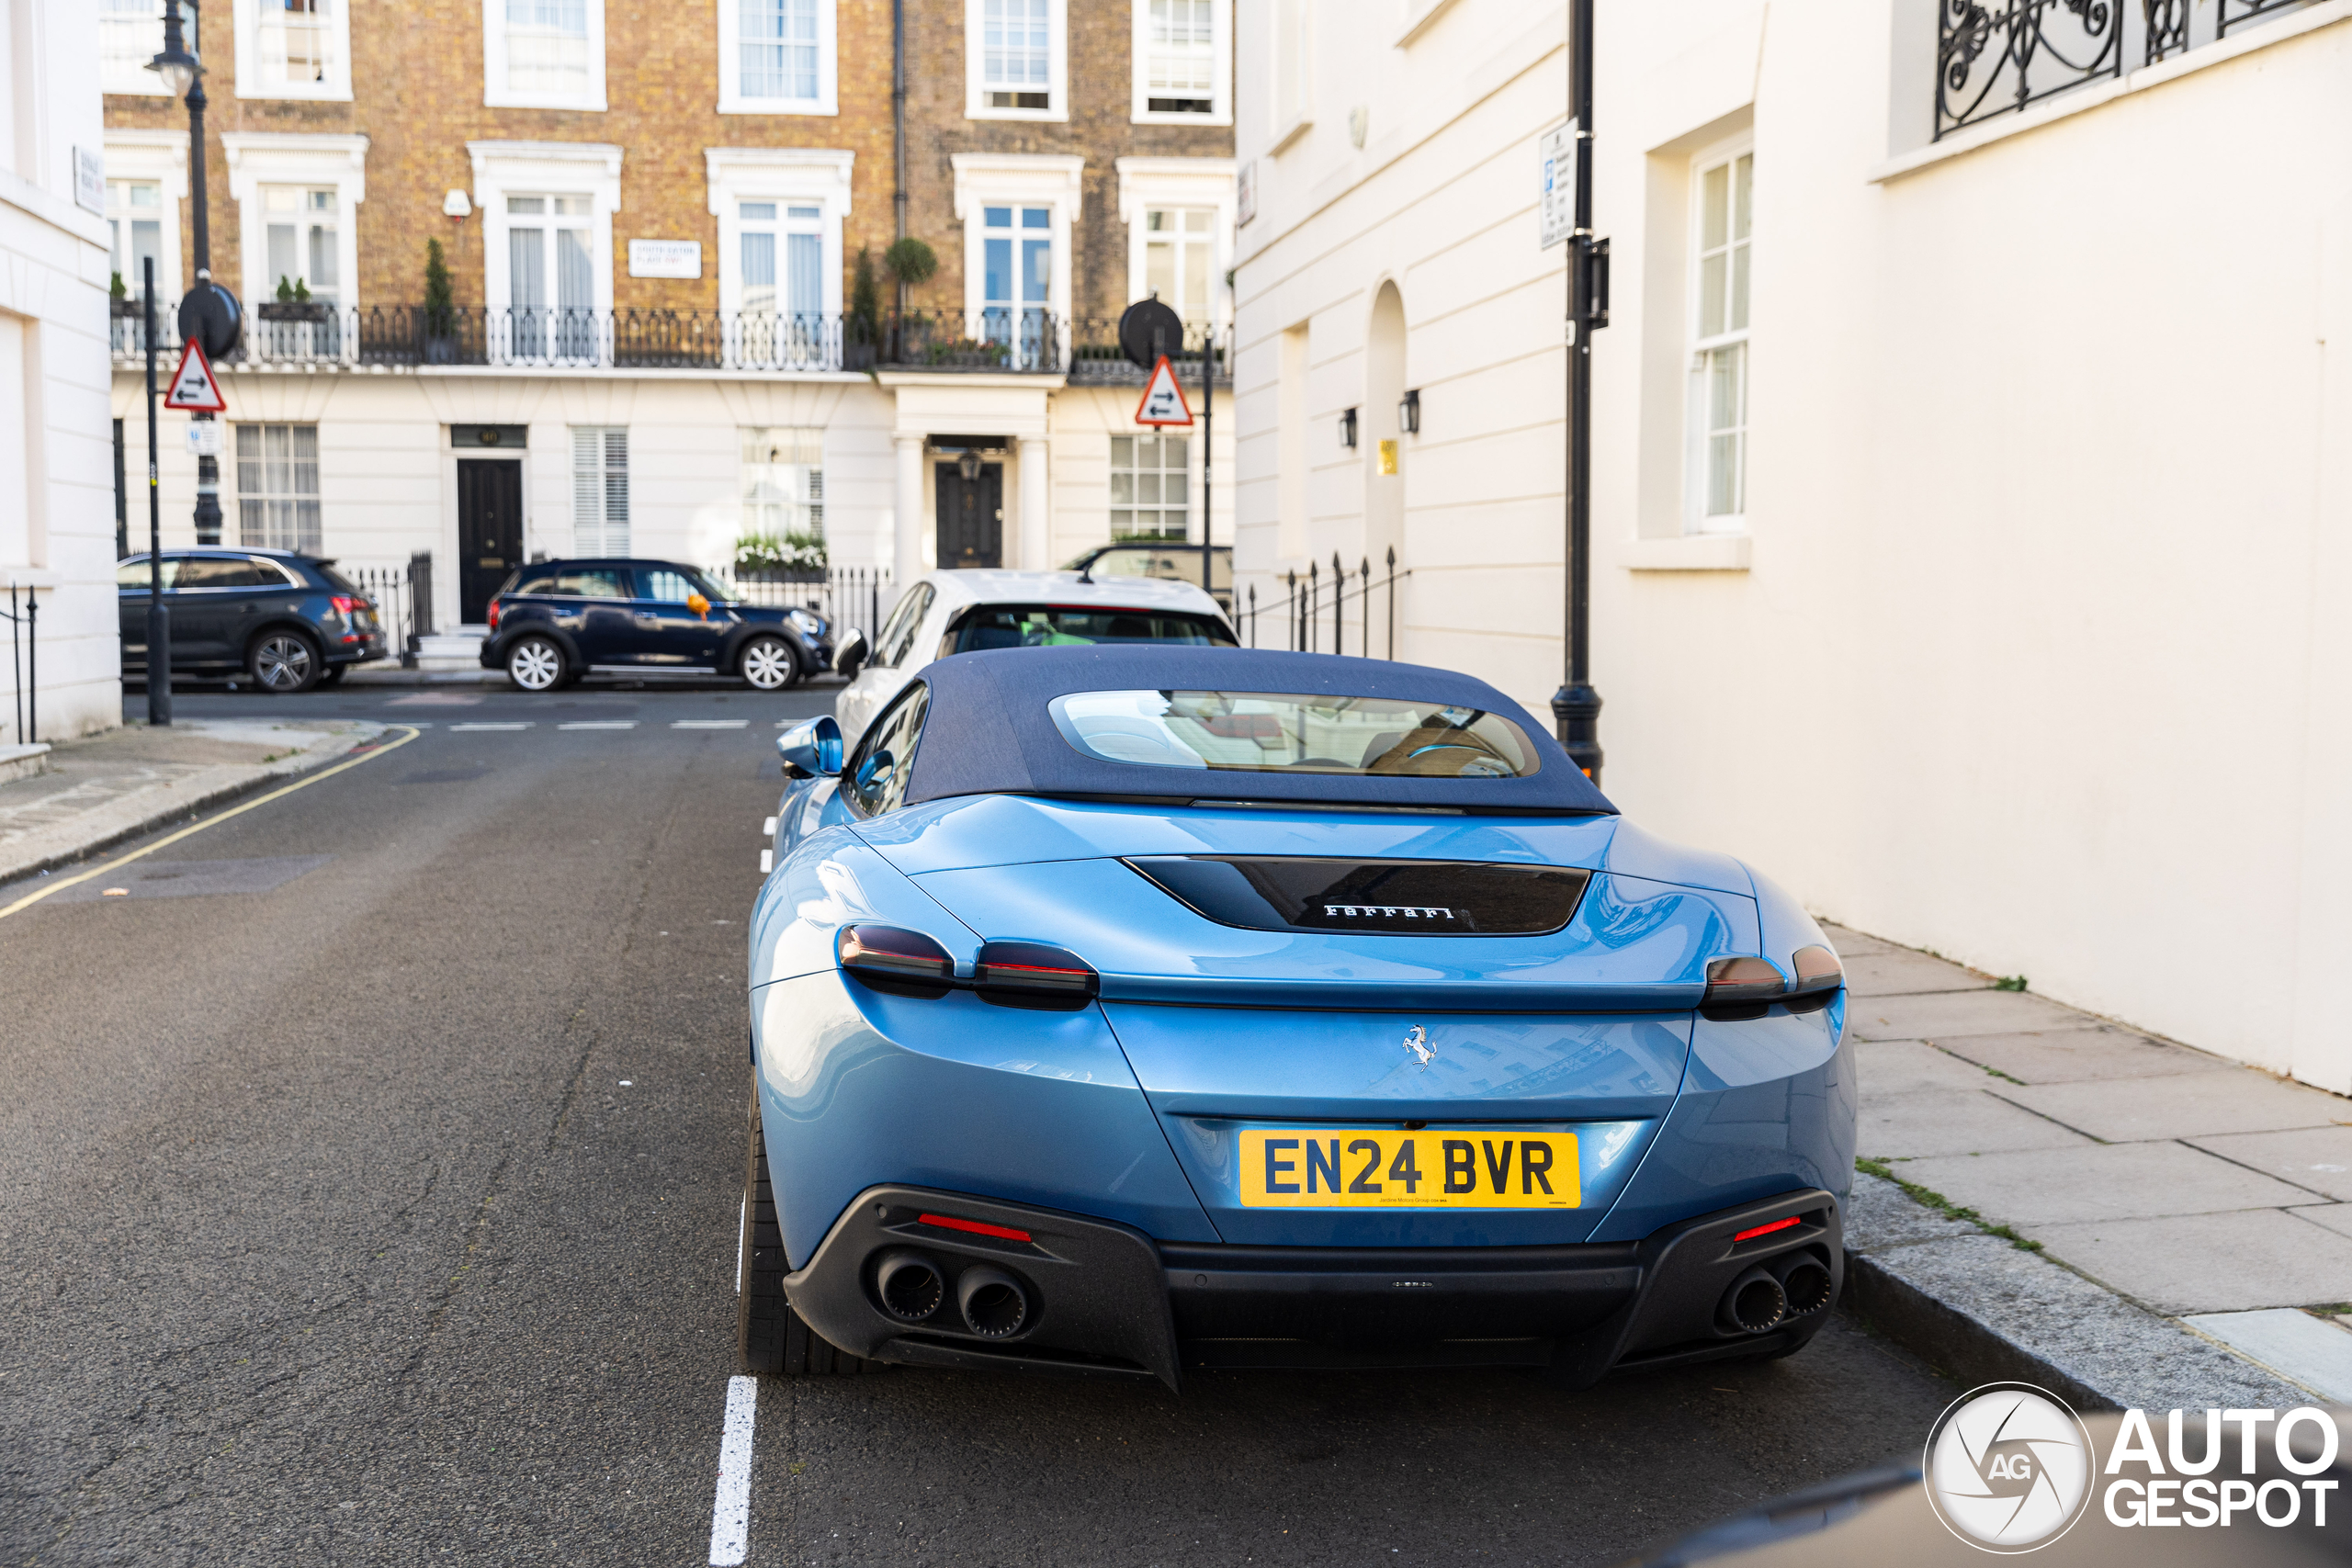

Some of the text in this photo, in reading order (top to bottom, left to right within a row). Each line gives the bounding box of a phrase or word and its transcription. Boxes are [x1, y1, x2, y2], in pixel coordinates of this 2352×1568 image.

[1324, 905, 1453, 919] Ferrari
[1265, 1139, 1555, 1195] EN24 BVR
